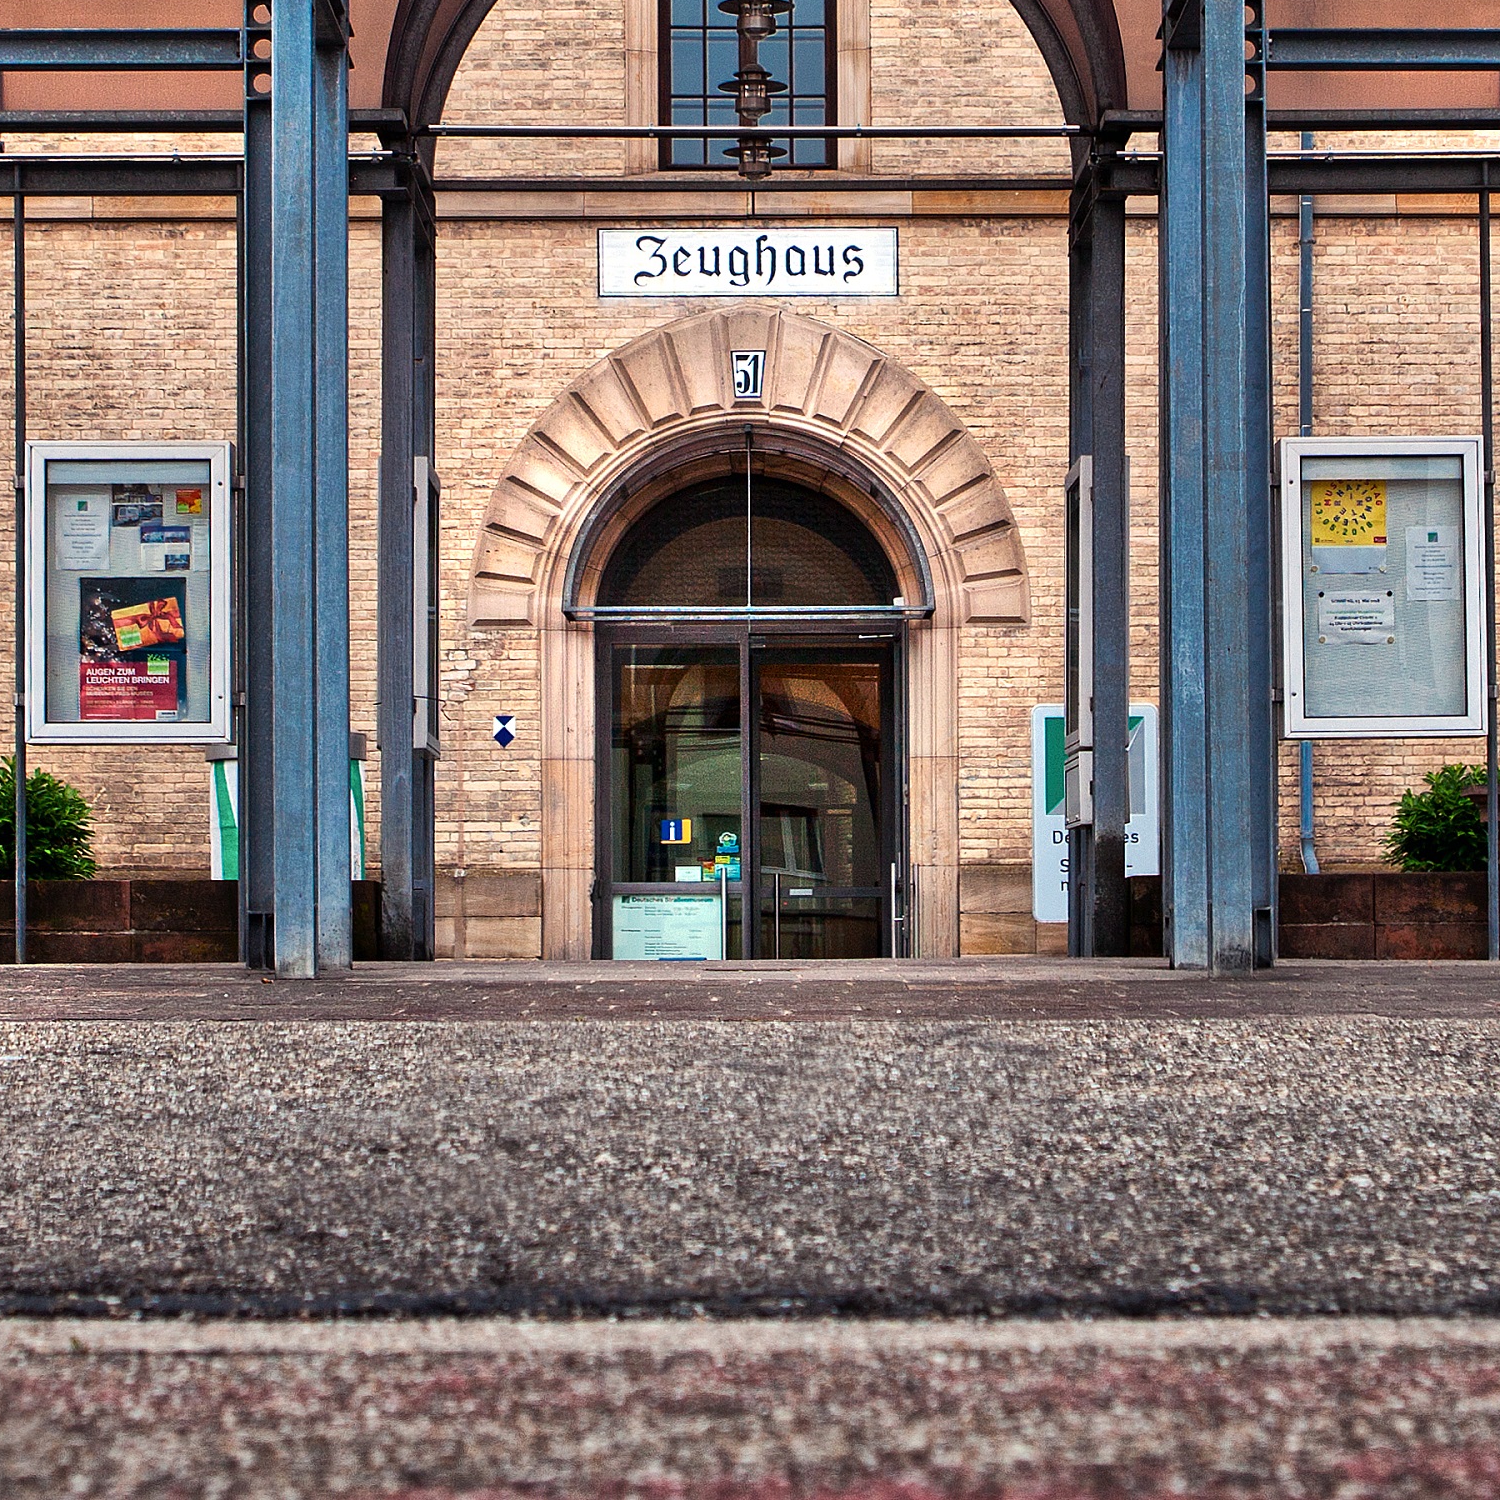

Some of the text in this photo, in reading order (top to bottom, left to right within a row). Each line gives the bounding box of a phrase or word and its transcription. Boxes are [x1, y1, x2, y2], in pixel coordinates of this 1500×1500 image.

[634, 235, 864, 287] Zeughaus
[735, 354, 759, 394] 51
[86, 668, 136, 676] AUGEN ZUM
[86, 676, 170, 684] LEUCHTEN BRINGEN
